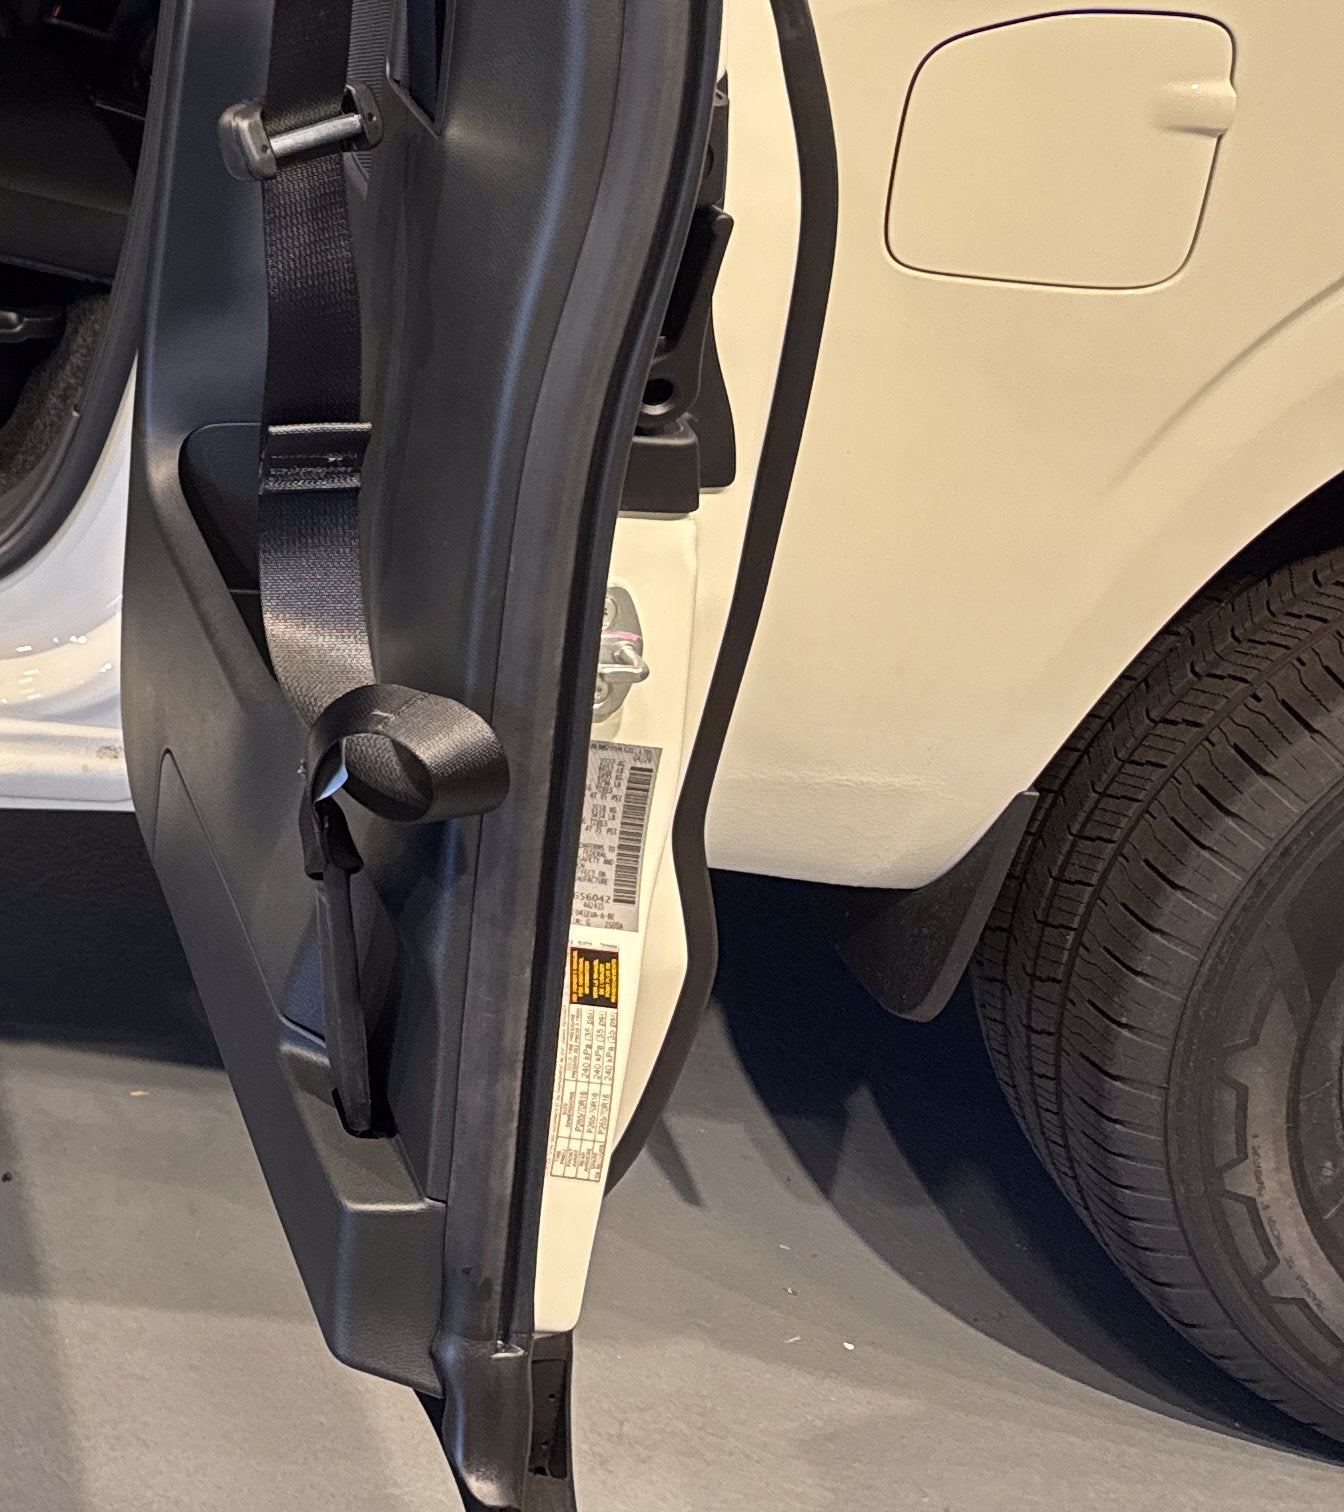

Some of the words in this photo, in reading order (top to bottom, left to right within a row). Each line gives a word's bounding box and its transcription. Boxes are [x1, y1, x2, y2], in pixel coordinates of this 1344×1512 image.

[582, 1044, 592, 1060] kPa
[594, 1045, 603, 1061] kPa
[605, 1046, 614, 1062] kPa
[581, 1062, 590, 1079] 240
[593, 1063, 602, 1080] 240
[604, 1064, 612, 1081] 240
